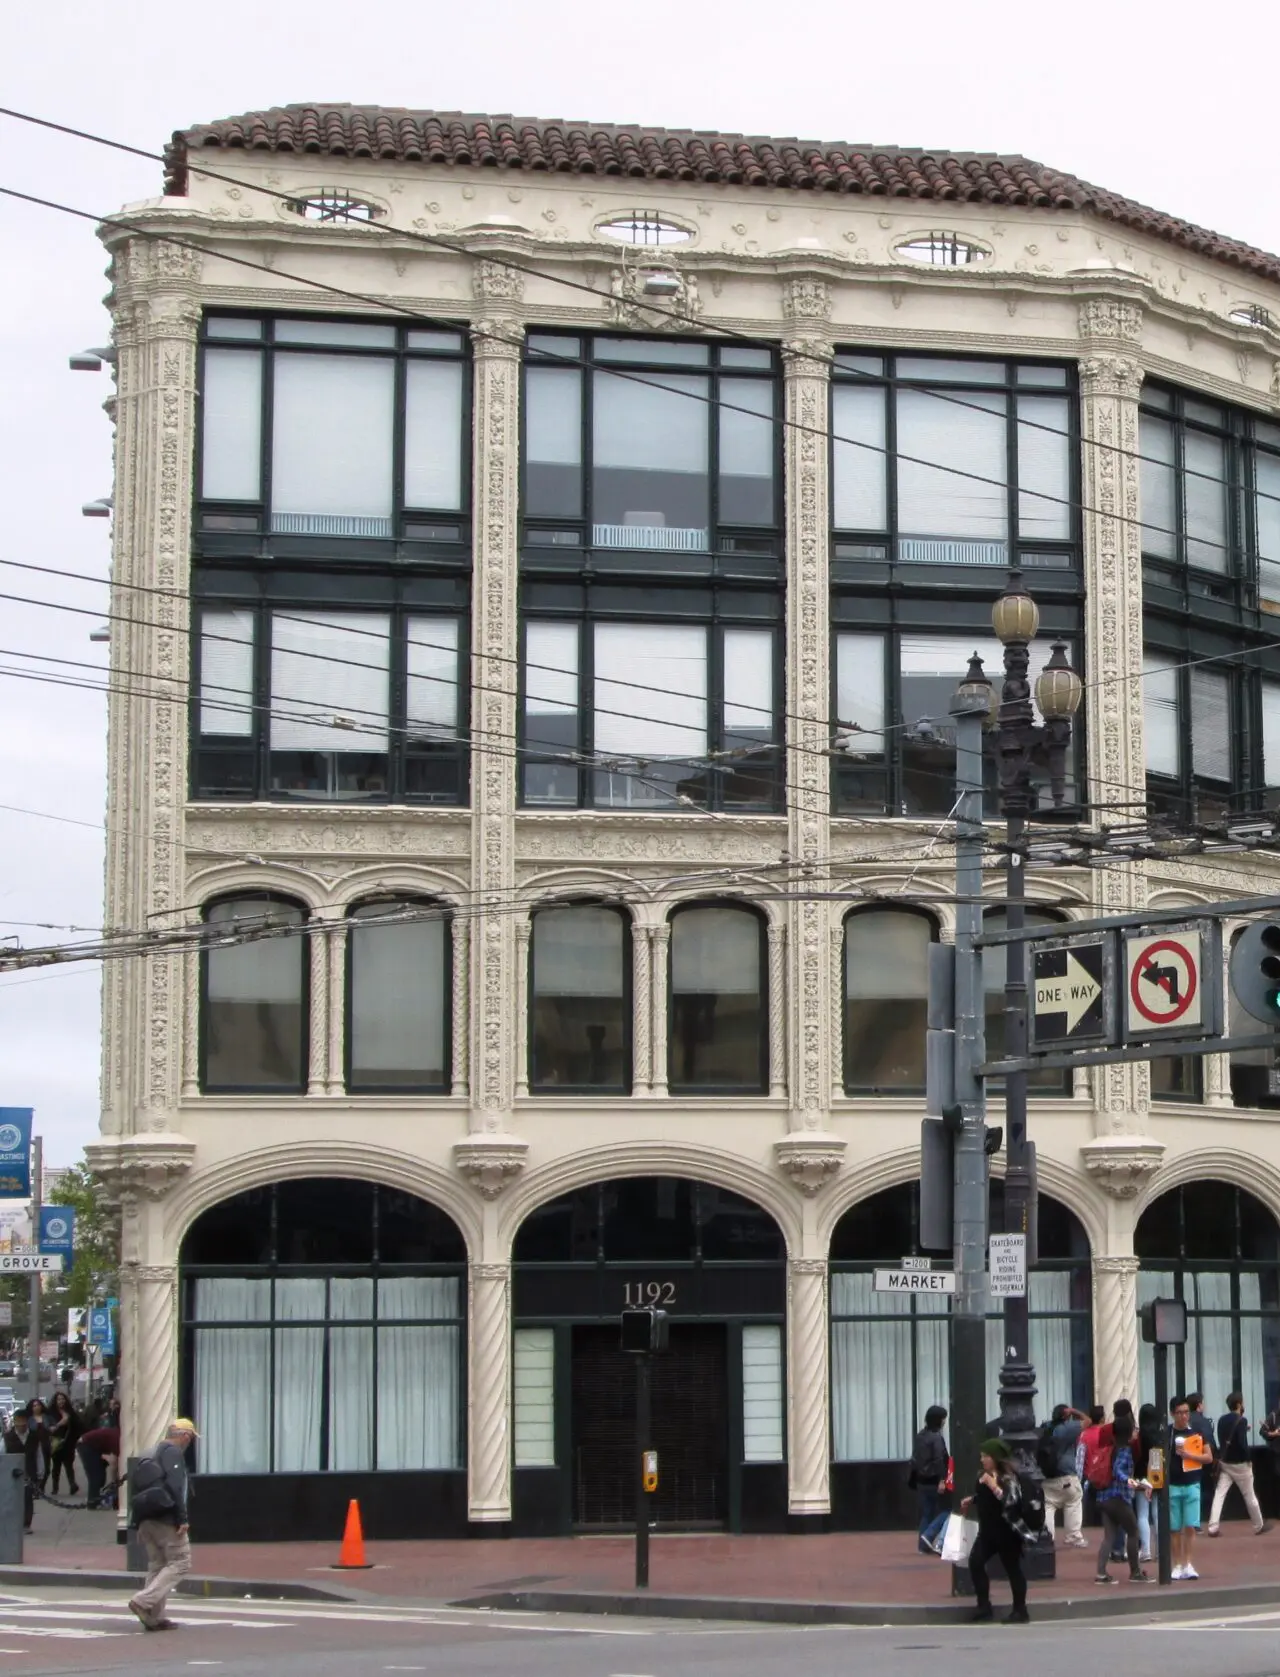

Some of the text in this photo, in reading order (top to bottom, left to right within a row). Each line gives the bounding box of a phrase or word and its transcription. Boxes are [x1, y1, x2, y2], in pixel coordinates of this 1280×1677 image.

[1037, 984, 1095, 1003] ONE WAY
[991, 1239, 1024, 1248] SKATEBOARD
[3, 1258, 49, 1267] GROVE
[912, 1259, 928, 1268] 1200
[997, 1256, 1018, 1264] BICYCLE
[889, 1274, 946, 1289] MARKET
[623, 1282, 677, 1305] 1192
